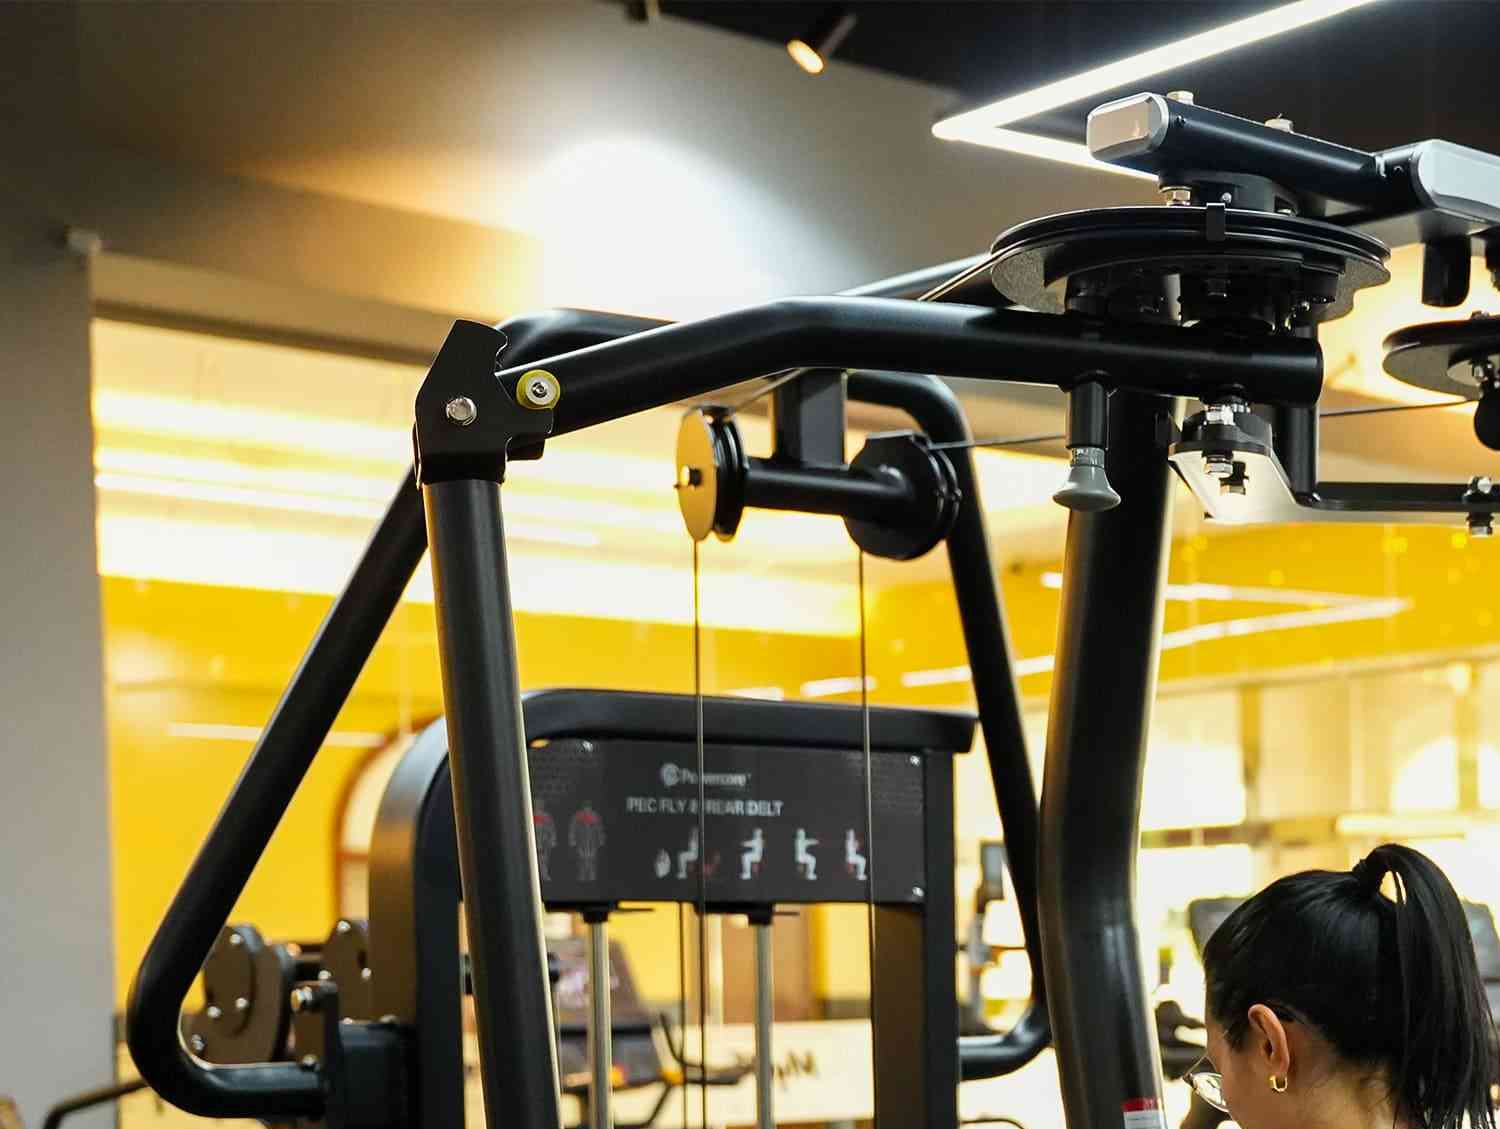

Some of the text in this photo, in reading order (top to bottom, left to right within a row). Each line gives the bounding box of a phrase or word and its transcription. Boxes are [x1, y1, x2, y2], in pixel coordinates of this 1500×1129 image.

[626, 796, 657, 814] PEC
[659, 797, 688, 815] FLY
[748, 799, 784, 817] DELT
